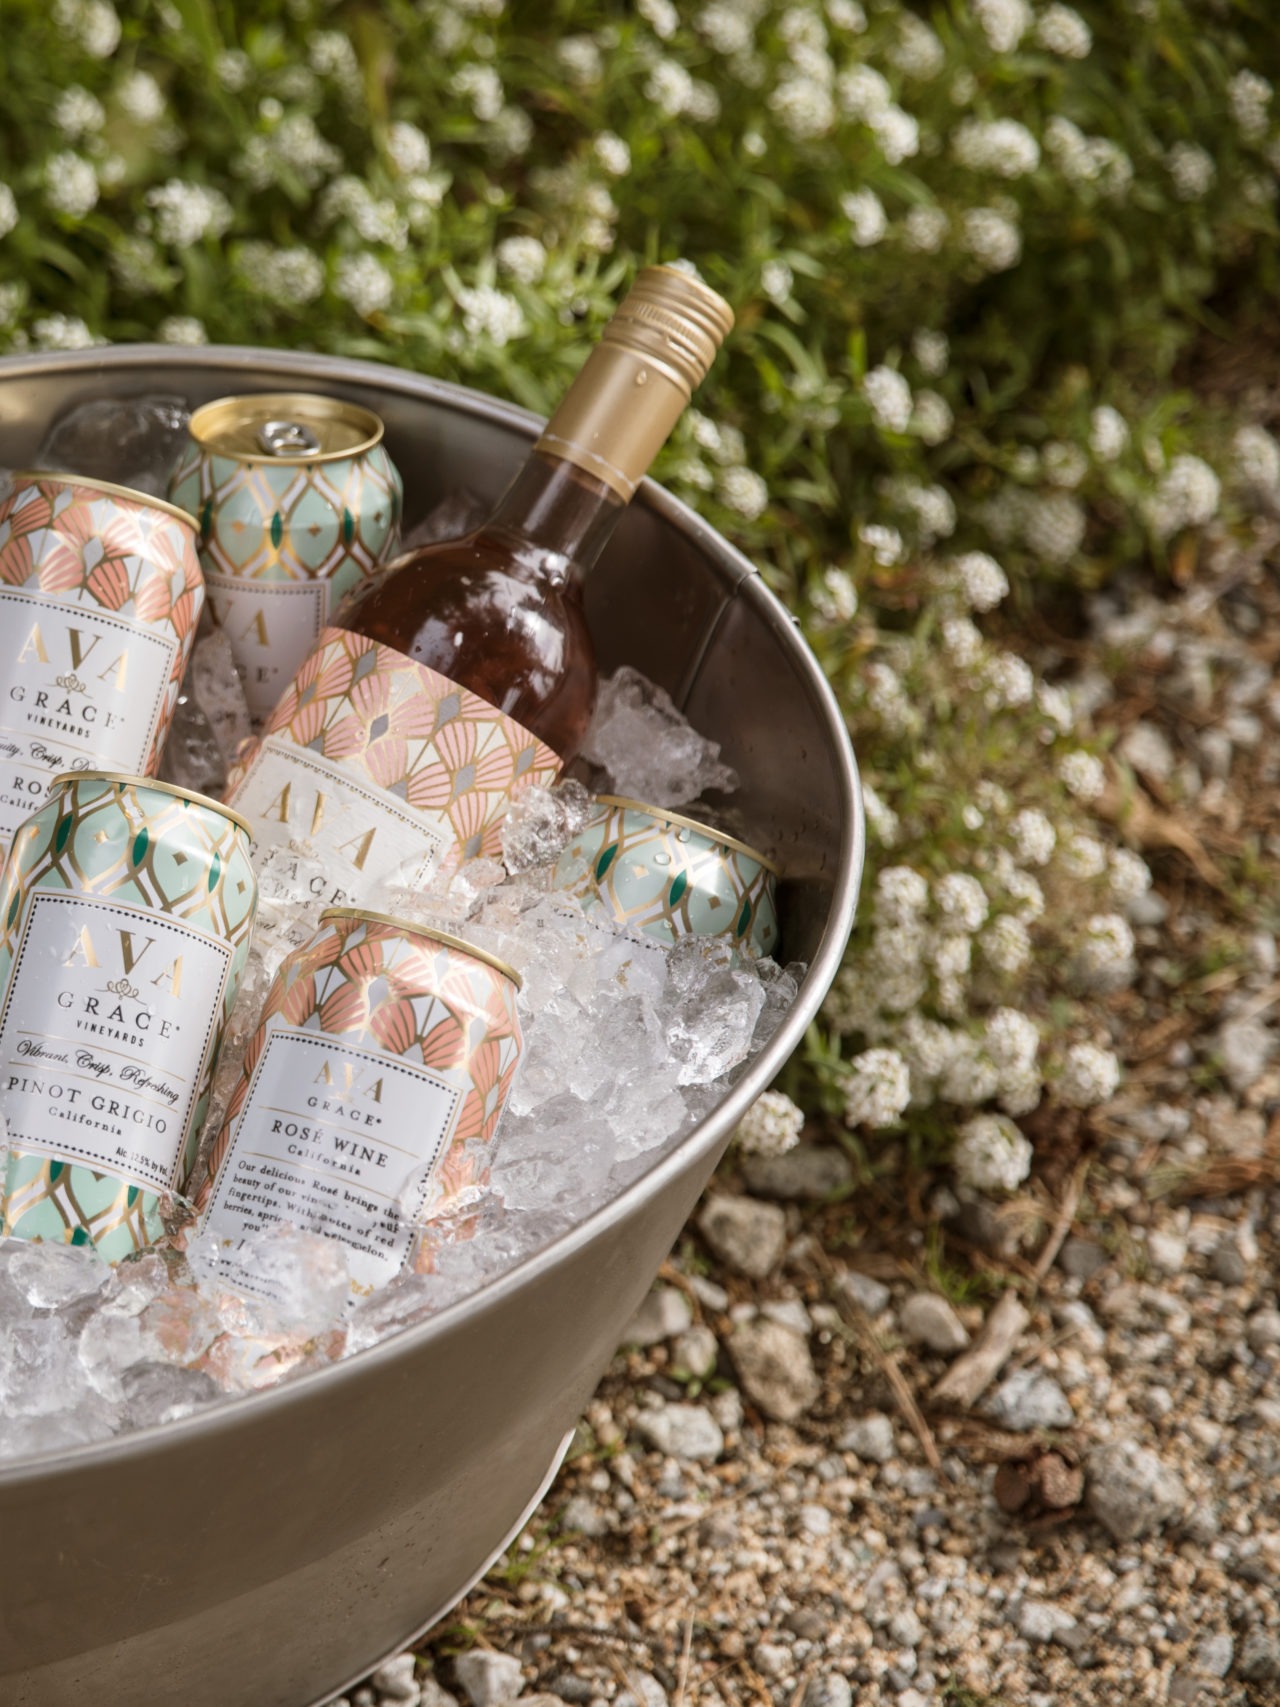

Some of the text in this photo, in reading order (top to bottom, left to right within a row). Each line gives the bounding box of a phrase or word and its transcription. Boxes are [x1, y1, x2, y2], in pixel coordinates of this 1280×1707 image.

[16, 621, 130, 693] AVA
[9, 685, 118, 731] GRACE
[27, 712, 91, 739] VINEYARDS
[29, 742, 65, 768] Crisp,
[62, 924, 184, 999] AVA
[57, 990, 173, 1039] GRACE
[76, 1019, 145, 1047] VINEYARDS
[16, 1039, 180, 1105] Vibrant, Crisp, Refreshing
[313, 1059, 385, 1104] AVA
[7, 1076, 168, 1134] PINOT GRIGIO
[48, 1106, 122, 1136] California
[307, 1096, 375, 1126] GRACE
[271, 1119, 389, 1168] ROSÉ WINE
[287, 1144, 361, 1176] California
[233, 1173, 261, 1190] beauty
[264, 1182, 277, 1192] of
[278, 1187, 296, 1197] our
[238, 1161, 256, 1172] Our
[260, 1165, 305, 1186] delicious
[312, 1180, 338, 1196] Rosé
[343, 1190, 378, 1213] brings
[384, 1207, 400, 1220] the
[223, 1200, 254, 1216] berries,
[228, 1187, 281, 1208] fingertips.
[357, 1228, 372, 1238] of
[375, 1234, 395, 1248] red
